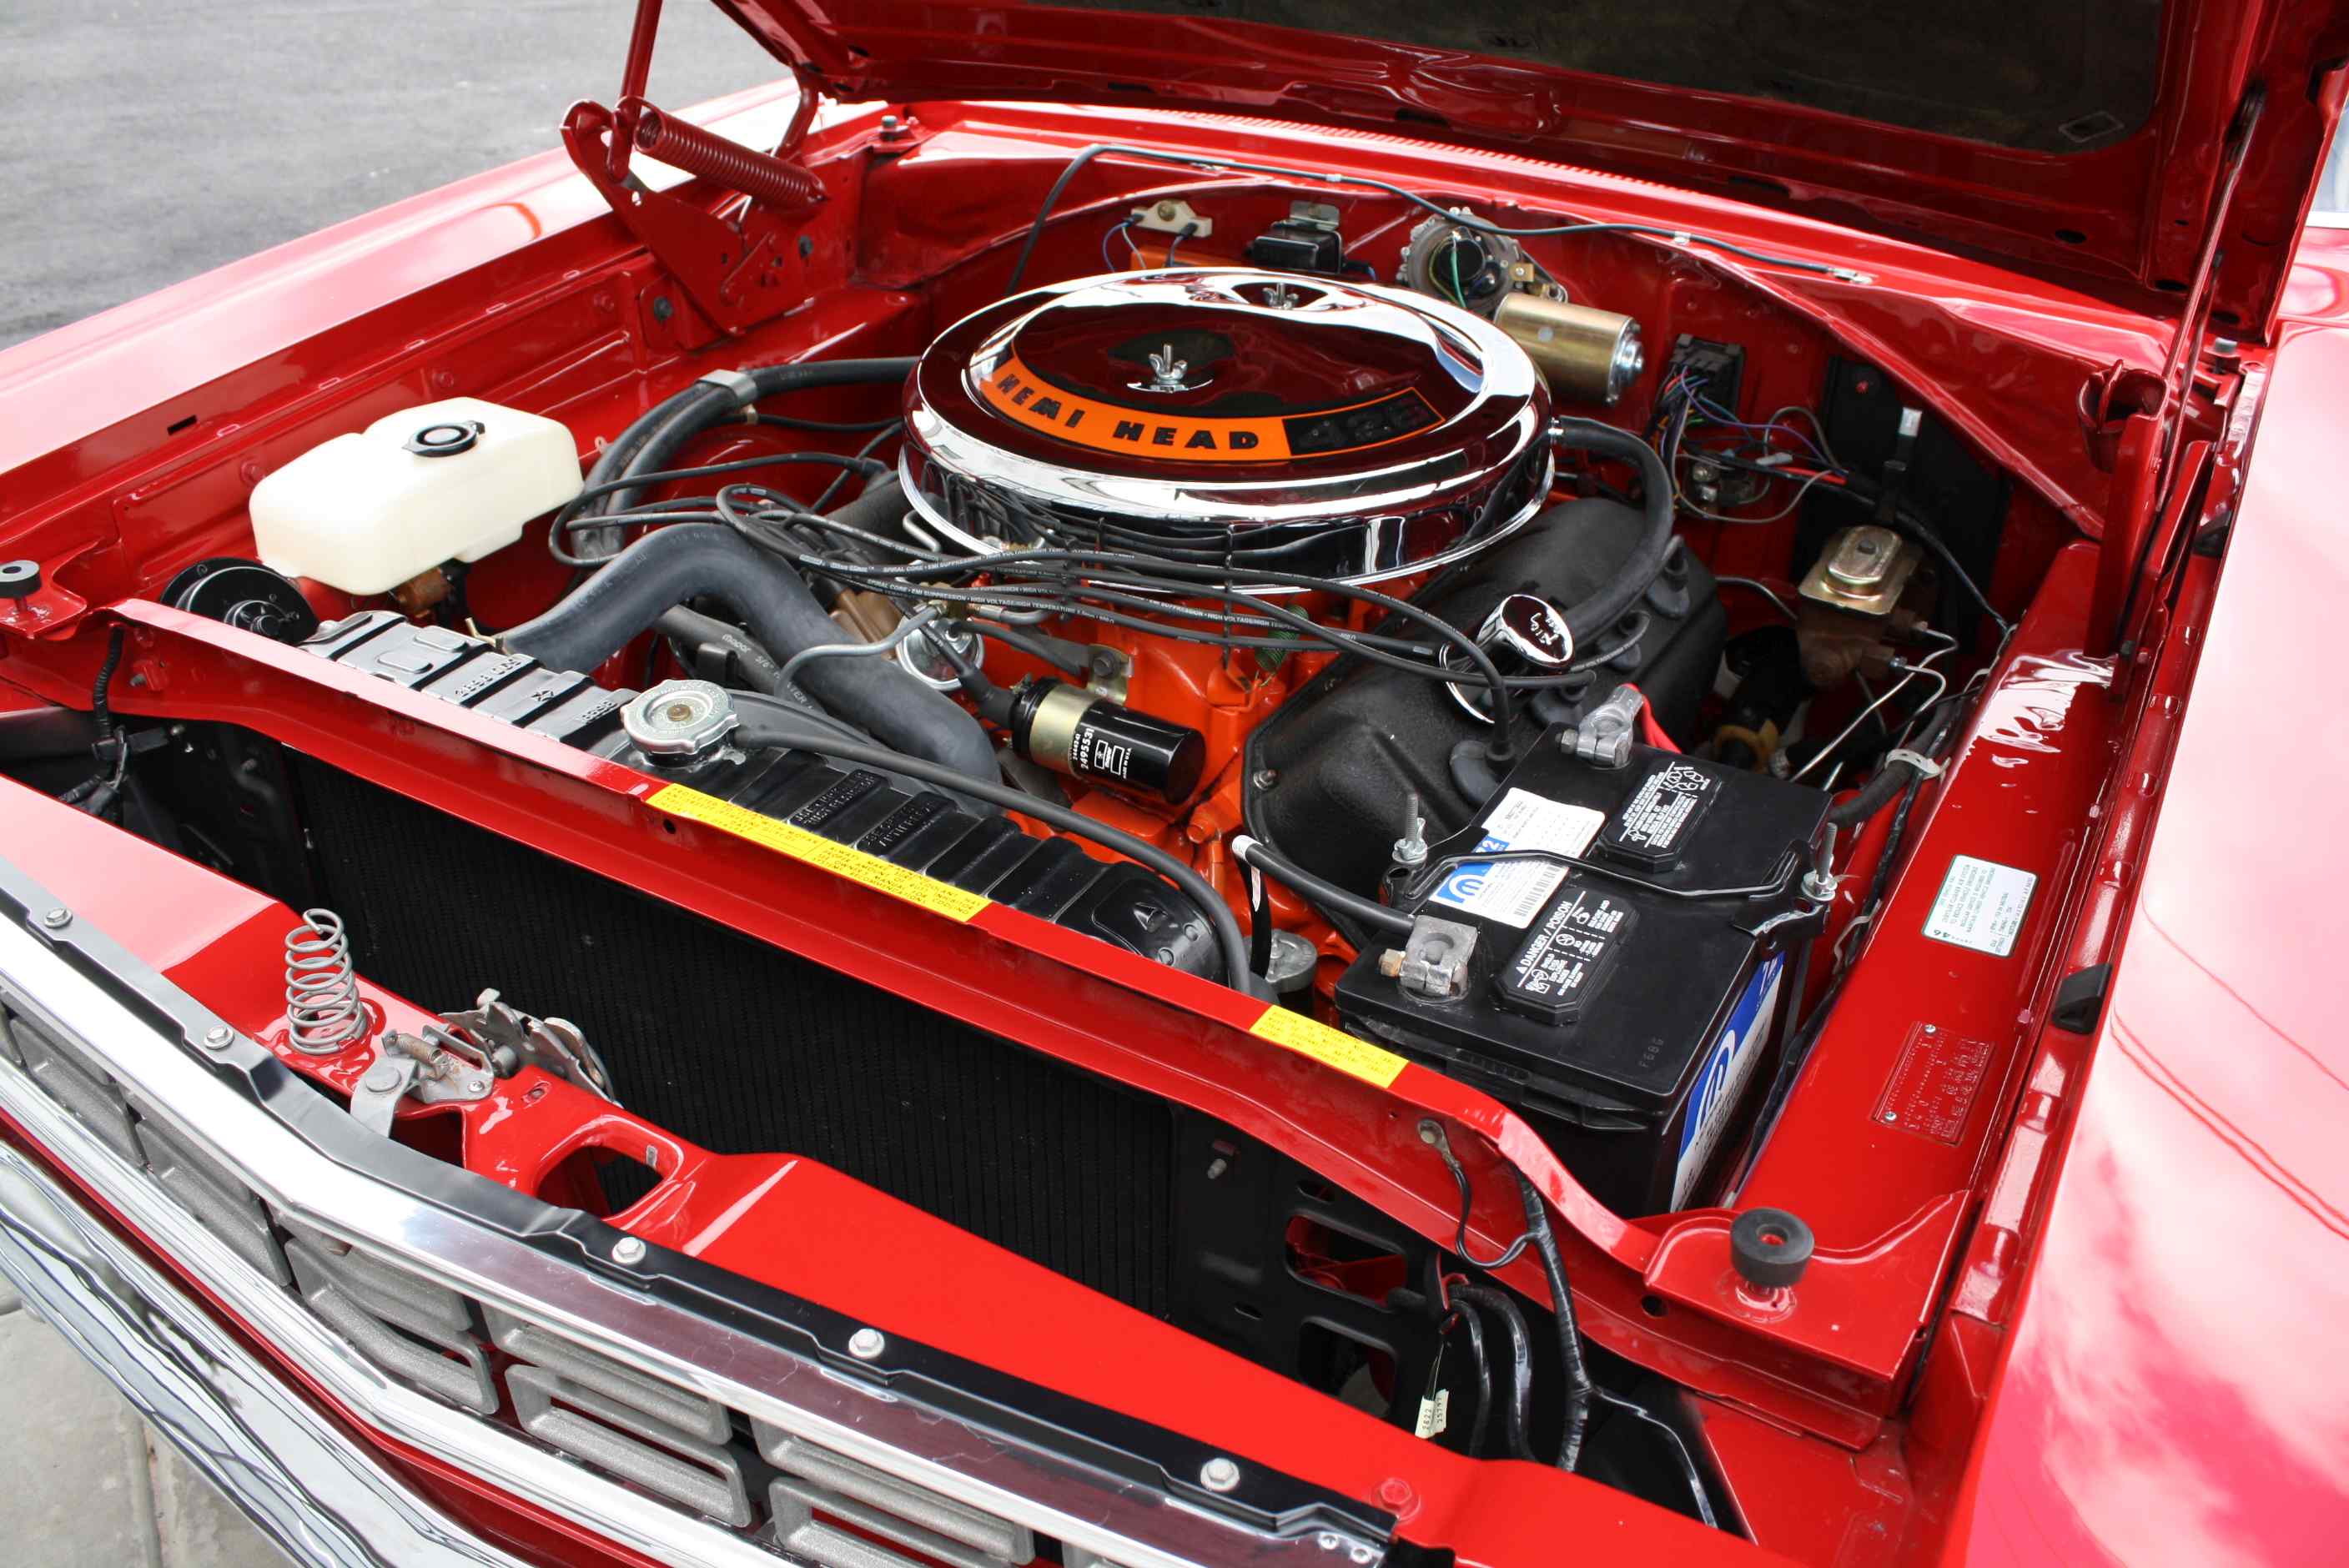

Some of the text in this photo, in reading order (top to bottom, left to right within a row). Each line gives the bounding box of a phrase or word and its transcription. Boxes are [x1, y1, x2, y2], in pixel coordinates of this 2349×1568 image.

[997, 374, 1085, 428] HEMI
[1112, 420, 1259, 450] HEAD
[1080, 727, 1094, 770] 2495531
[1520, 934, 1550, 967] DANGER
[1546, 901, 1573, 929] POISON
